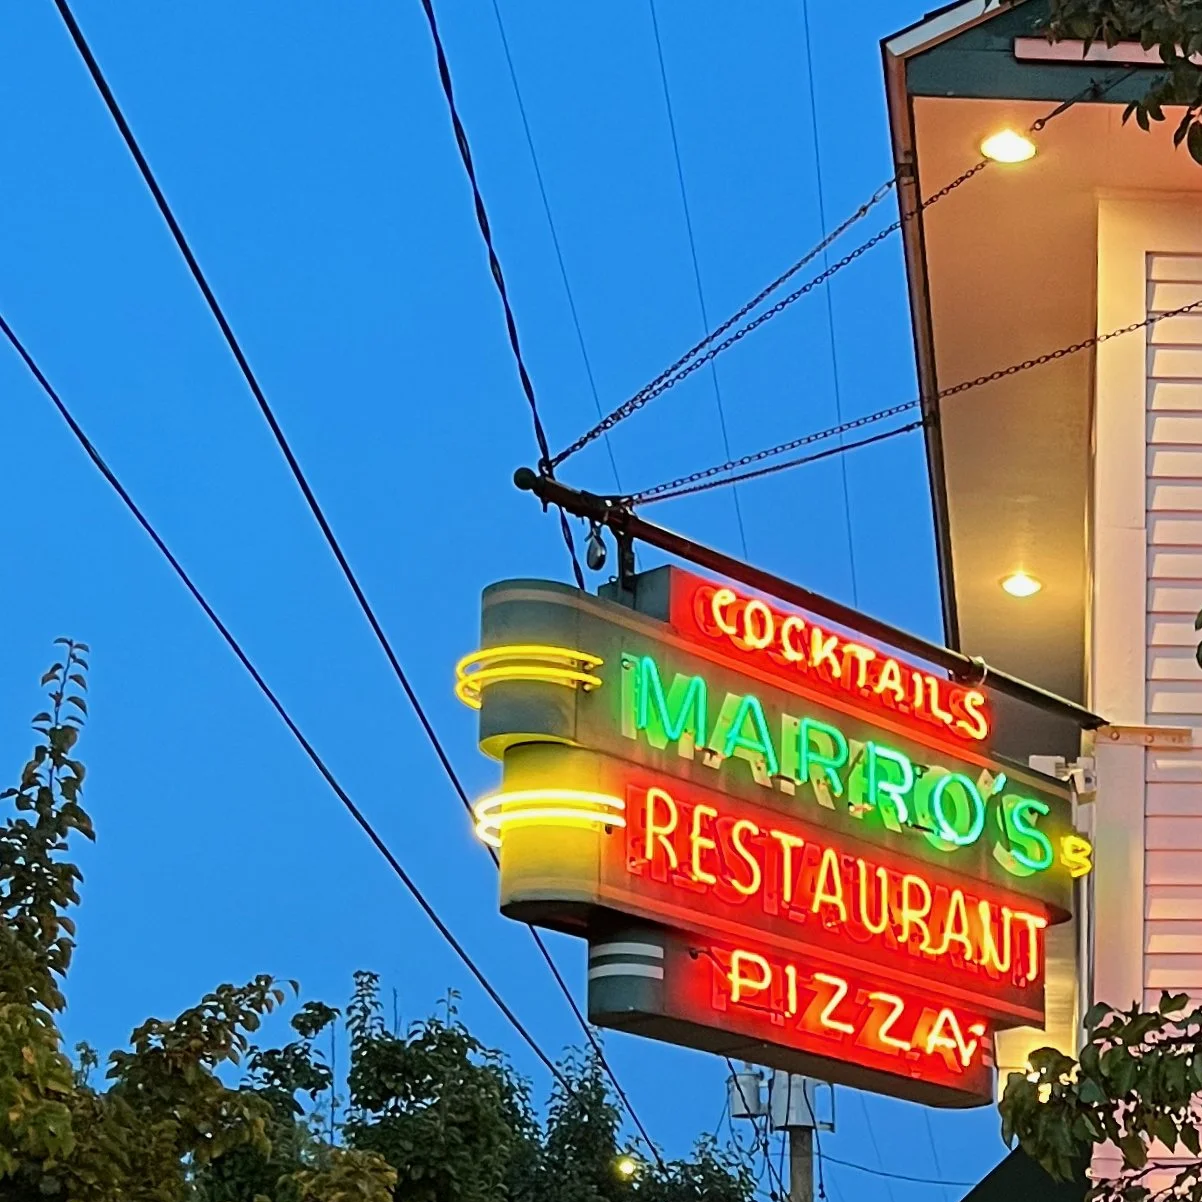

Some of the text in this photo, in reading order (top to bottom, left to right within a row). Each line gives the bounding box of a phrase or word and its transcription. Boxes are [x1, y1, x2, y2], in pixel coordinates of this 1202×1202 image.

[704, 586, 989, 742] COCKTAILS
[630, 655, 1054, 872] MARRO'S
[642, 786, 1050, 983] RESTAURANT
[725, 947, 989, 1068] PIZZA
